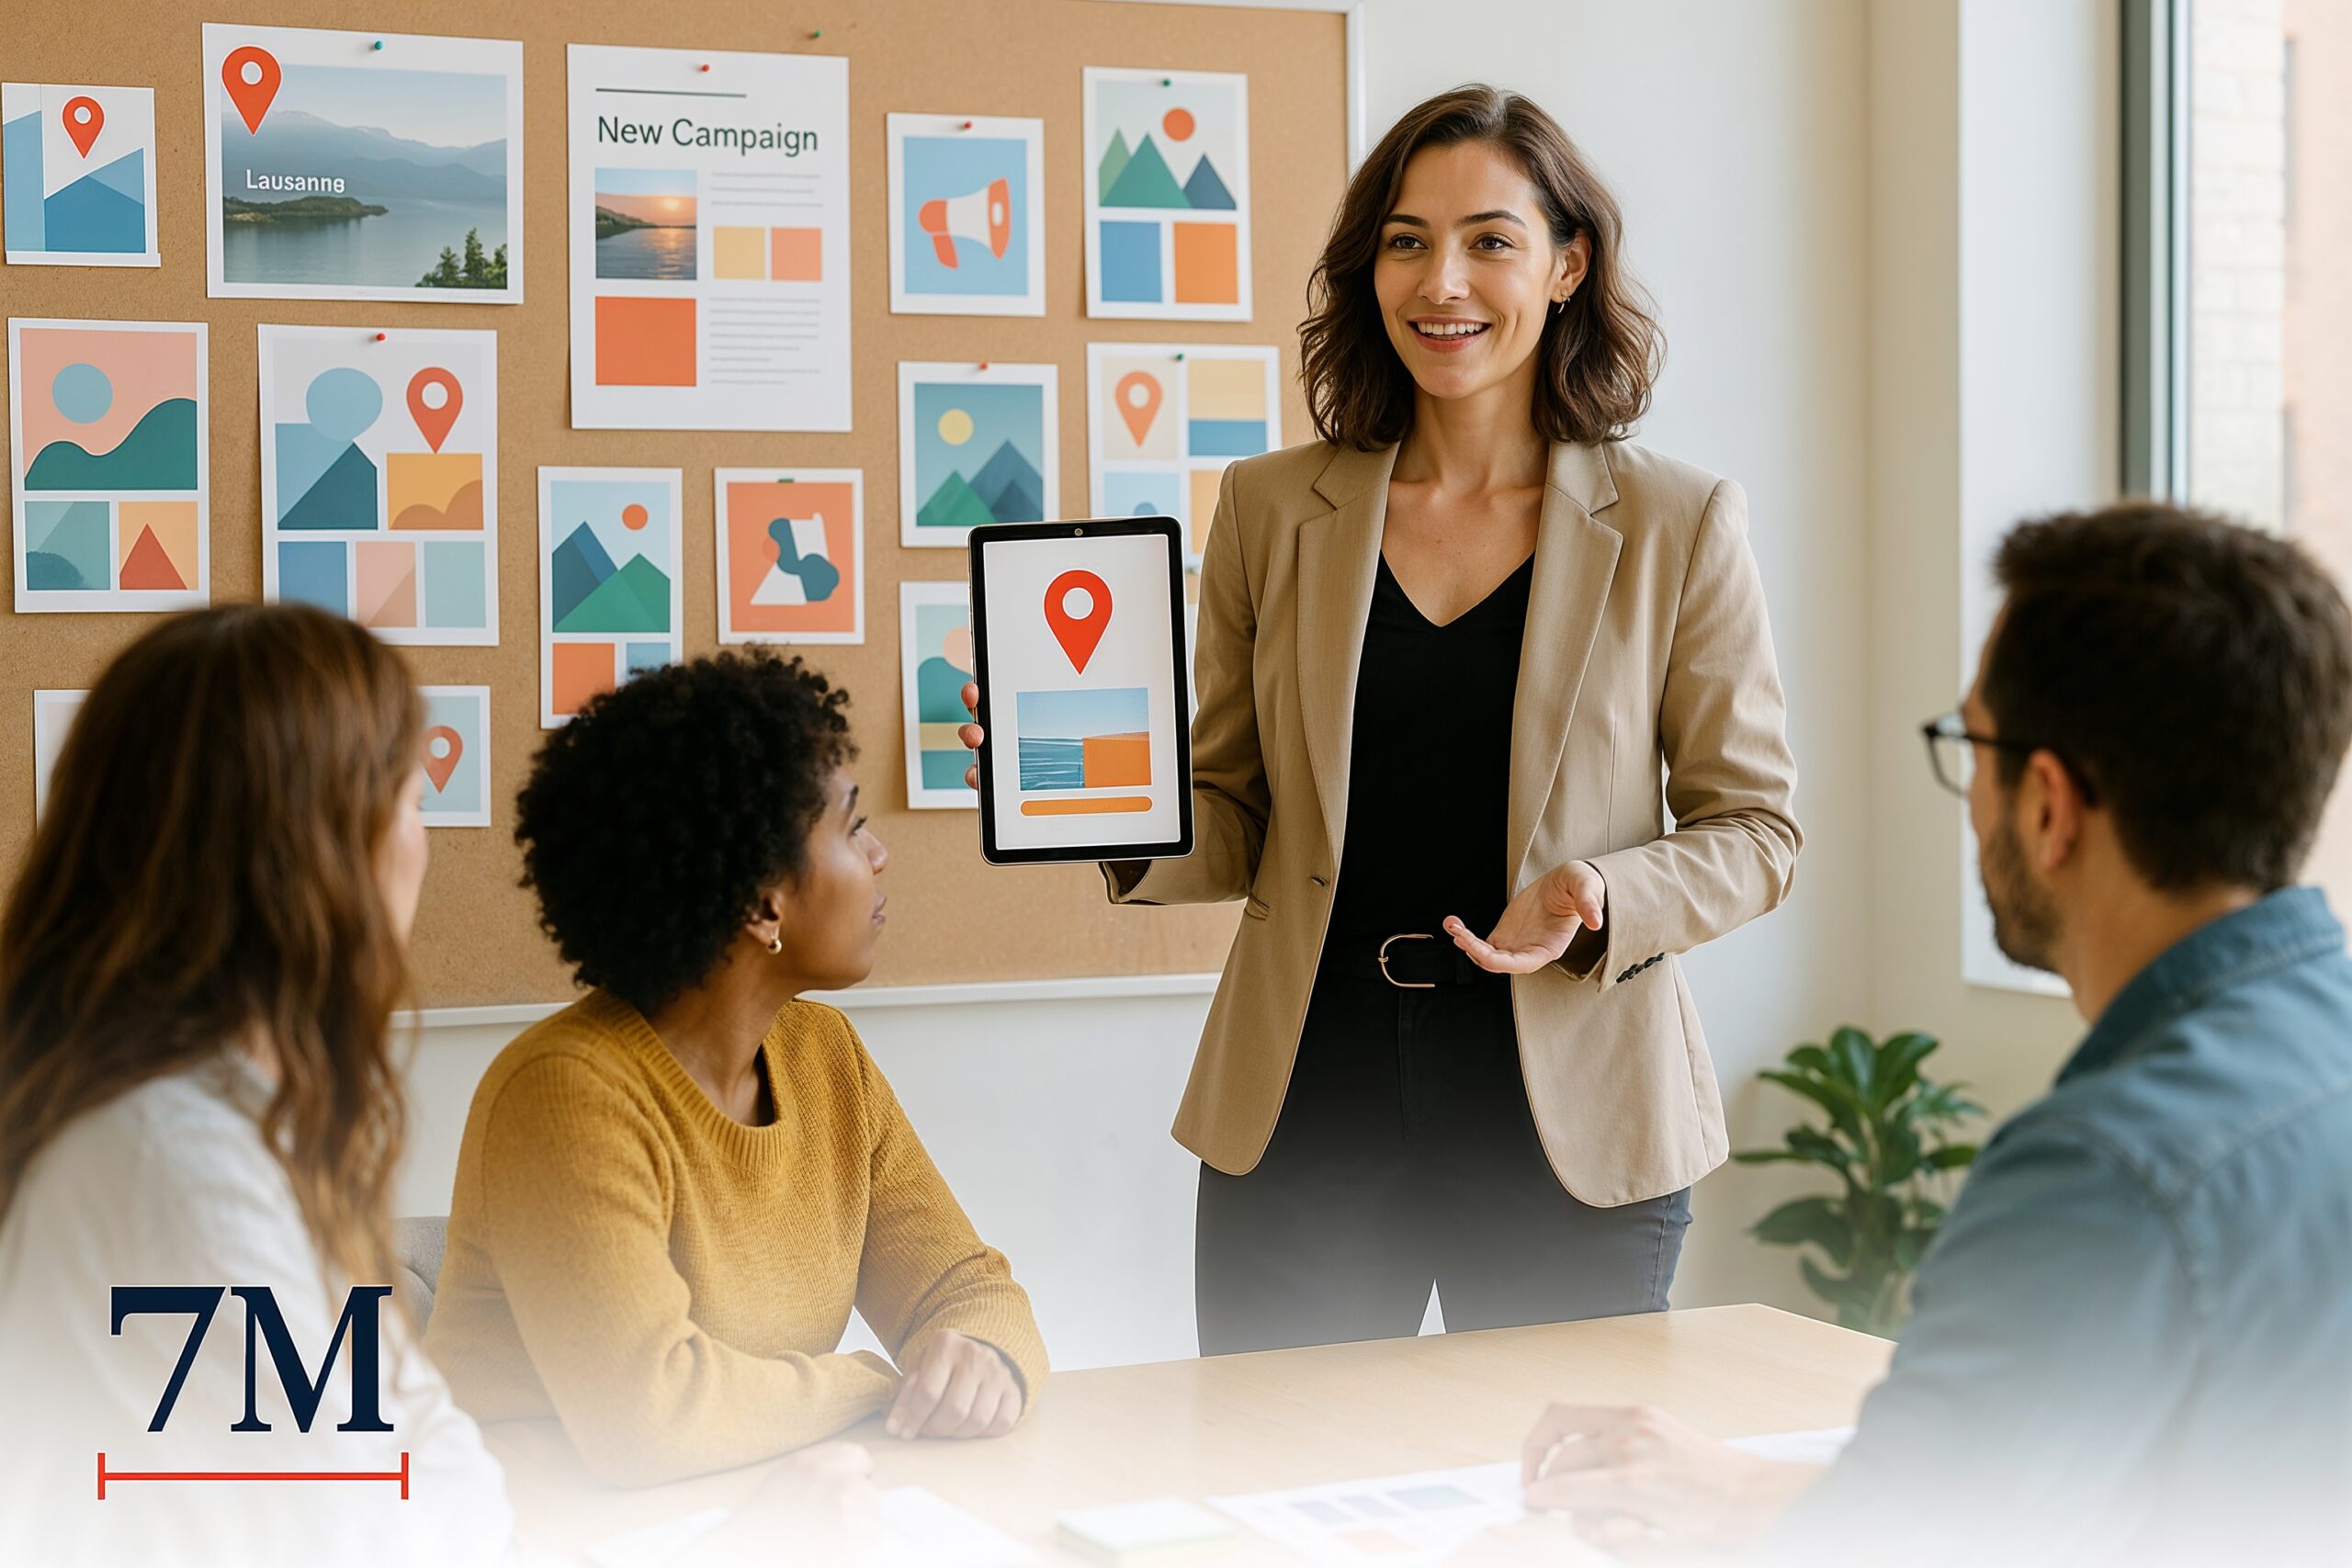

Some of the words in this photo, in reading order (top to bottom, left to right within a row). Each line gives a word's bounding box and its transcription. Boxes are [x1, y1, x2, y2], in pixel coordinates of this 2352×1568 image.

[598, 116, 663, 144] New
[672, 118, 819, 158] Campaign
[245, 168, 345, 194] Lausanne
